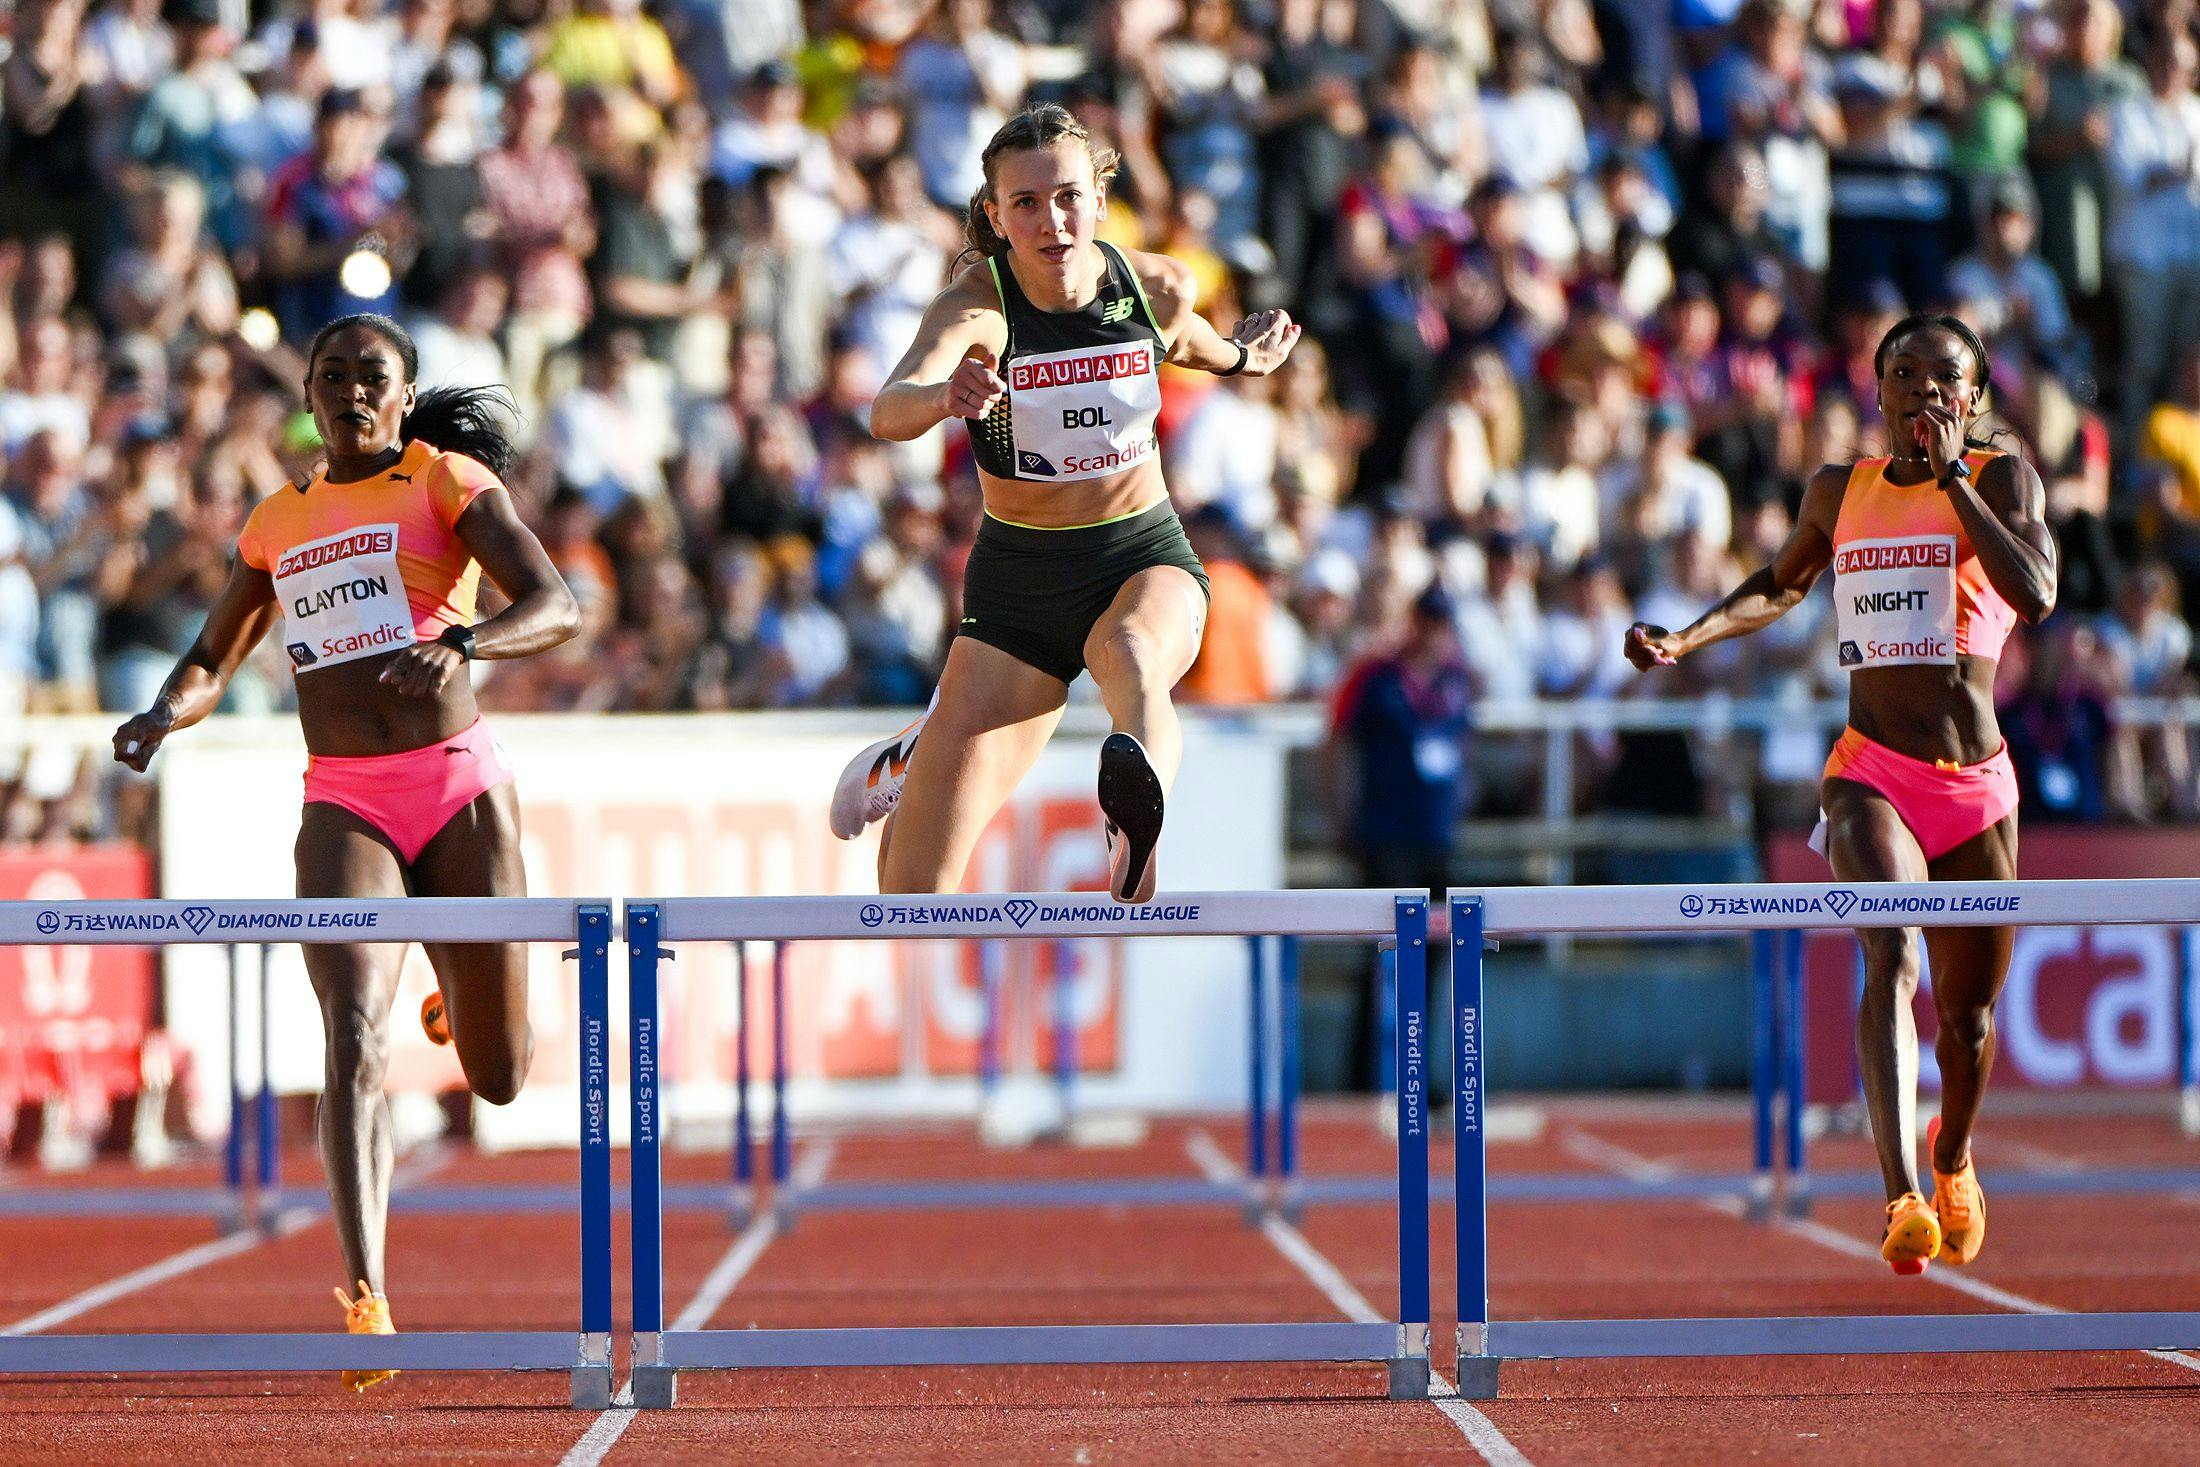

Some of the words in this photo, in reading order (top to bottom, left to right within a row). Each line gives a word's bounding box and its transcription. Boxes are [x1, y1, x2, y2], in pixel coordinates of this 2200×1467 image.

[1015, 351, 1149, 389] BAUHAUS
[1062, 406, 1112, 430] BOL
[1063, 440, 1148, 474] Scandic
[278, 534, 391, 577] BAUHAUS
[1837, 544, 1949, 573] BAUHAUS
[294, 575, 389, 619] CLAYTON
[1853, 590, 1929, 616] KNIGHT
[322, 623, 407, 658] Scandic
[1867, 637, 1947, 659] Scandic
[217, 913, 303, 929] DIAMOND
[307, 912, 379, 928] LEAGUE
[1039, 906, 1126, 922] DIAMOND
[1129, 905, 1201, 921] LEAGUE
[1860, 897, 1946, 913] DIAMOND
[1949, 896, 2021, 912] LEAGUE
[589, 1020, 603, 1085] nordic
[639, 1018, 654, 1083] nordic
[1408, 1011, 1421, 1075] nordic
[1464, 1007, 1478, 1072] nordic
[586, 1088, 602, 1145] Sport
[637, 1087, 653, 1143] Sport
[1405, 1080, 1420, 1136] Sport
[1462, 1076, 1477, 1132] Sport
